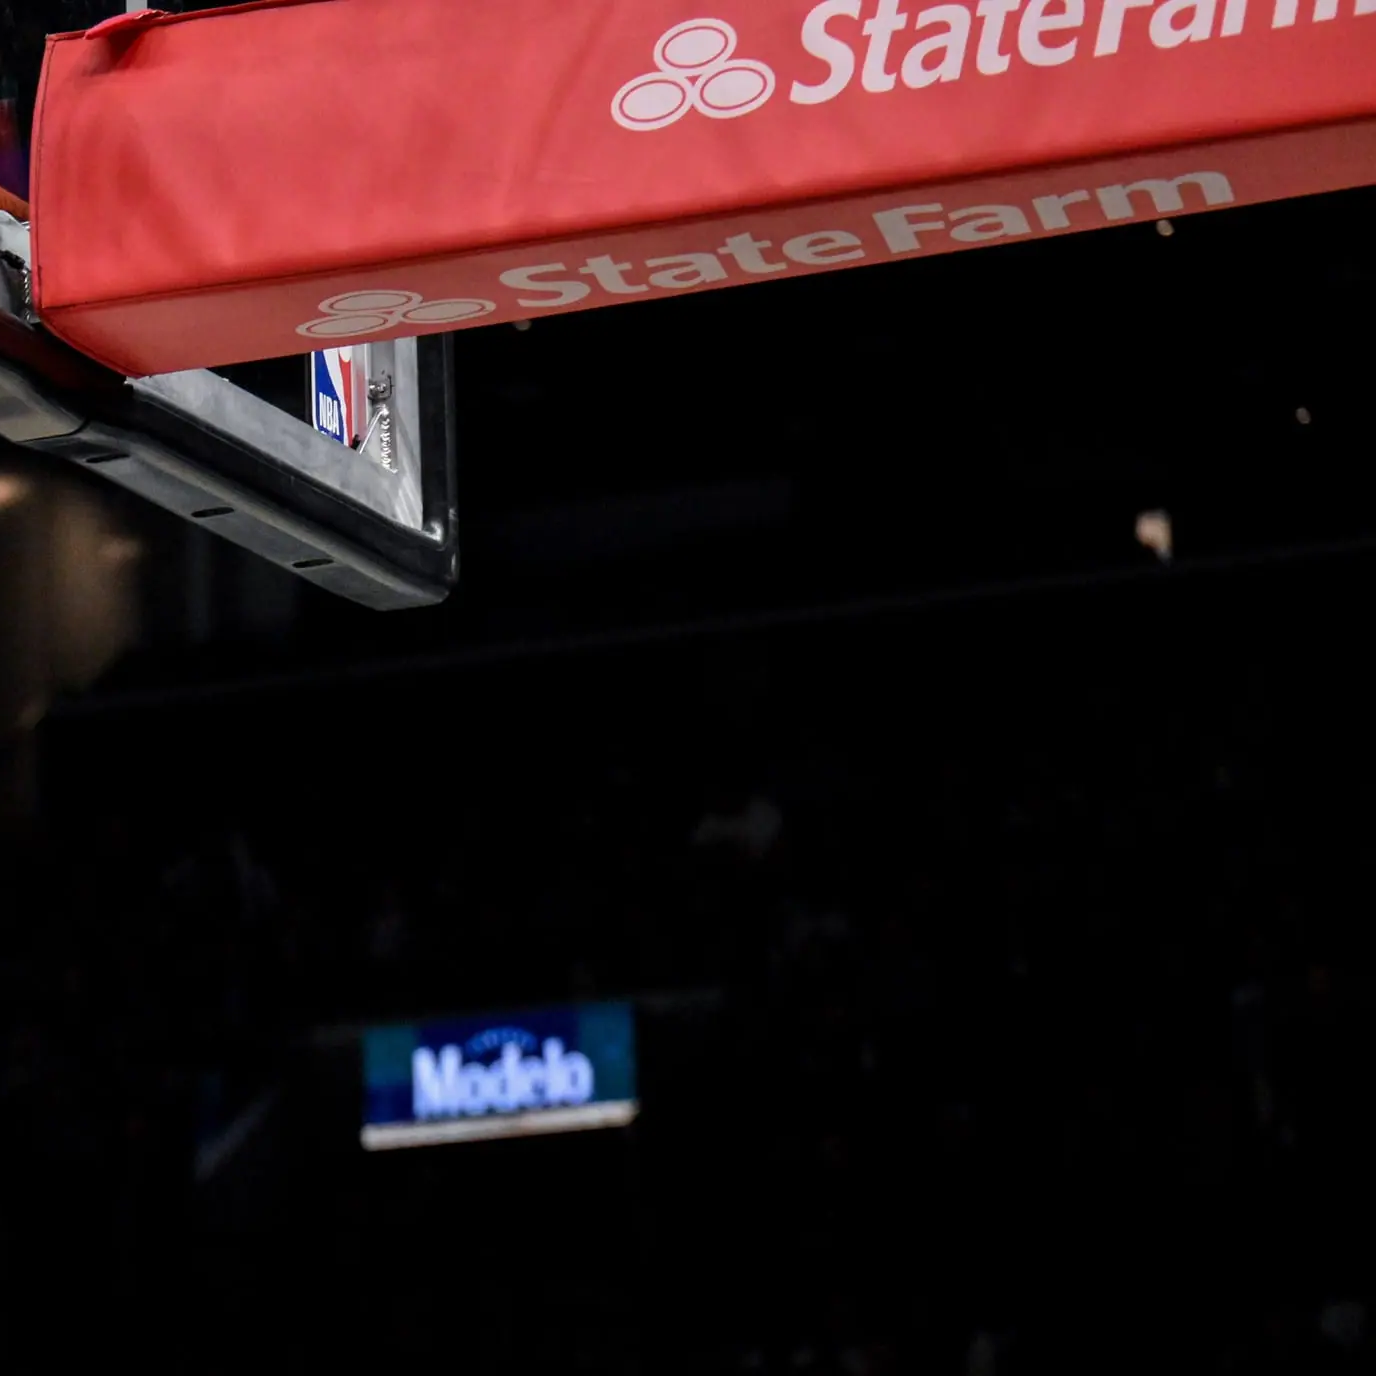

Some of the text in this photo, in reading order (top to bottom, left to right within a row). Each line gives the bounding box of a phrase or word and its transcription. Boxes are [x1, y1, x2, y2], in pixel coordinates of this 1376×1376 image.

[499, 169, 1235, 307] State Farm
[319, 391, 340, 436] NBA
[412, 1037, 594, 1119] Modelo
